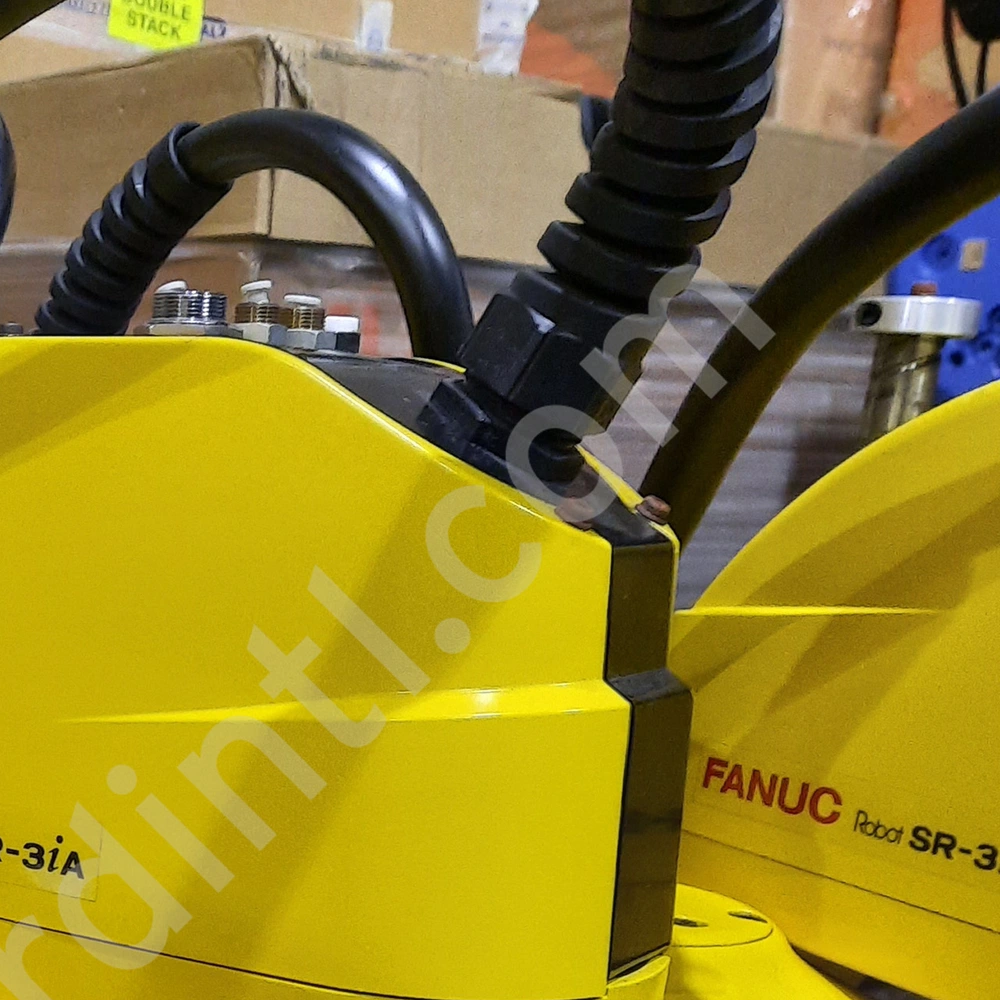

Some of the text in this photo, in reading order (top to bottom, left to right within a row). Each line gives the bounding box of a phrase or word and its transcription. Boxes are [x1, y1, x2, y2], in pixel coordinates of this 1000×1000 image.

[127, 10, 181, 40] STACK
[702, 757, 1000, 873] FANUC Robot SR-3
